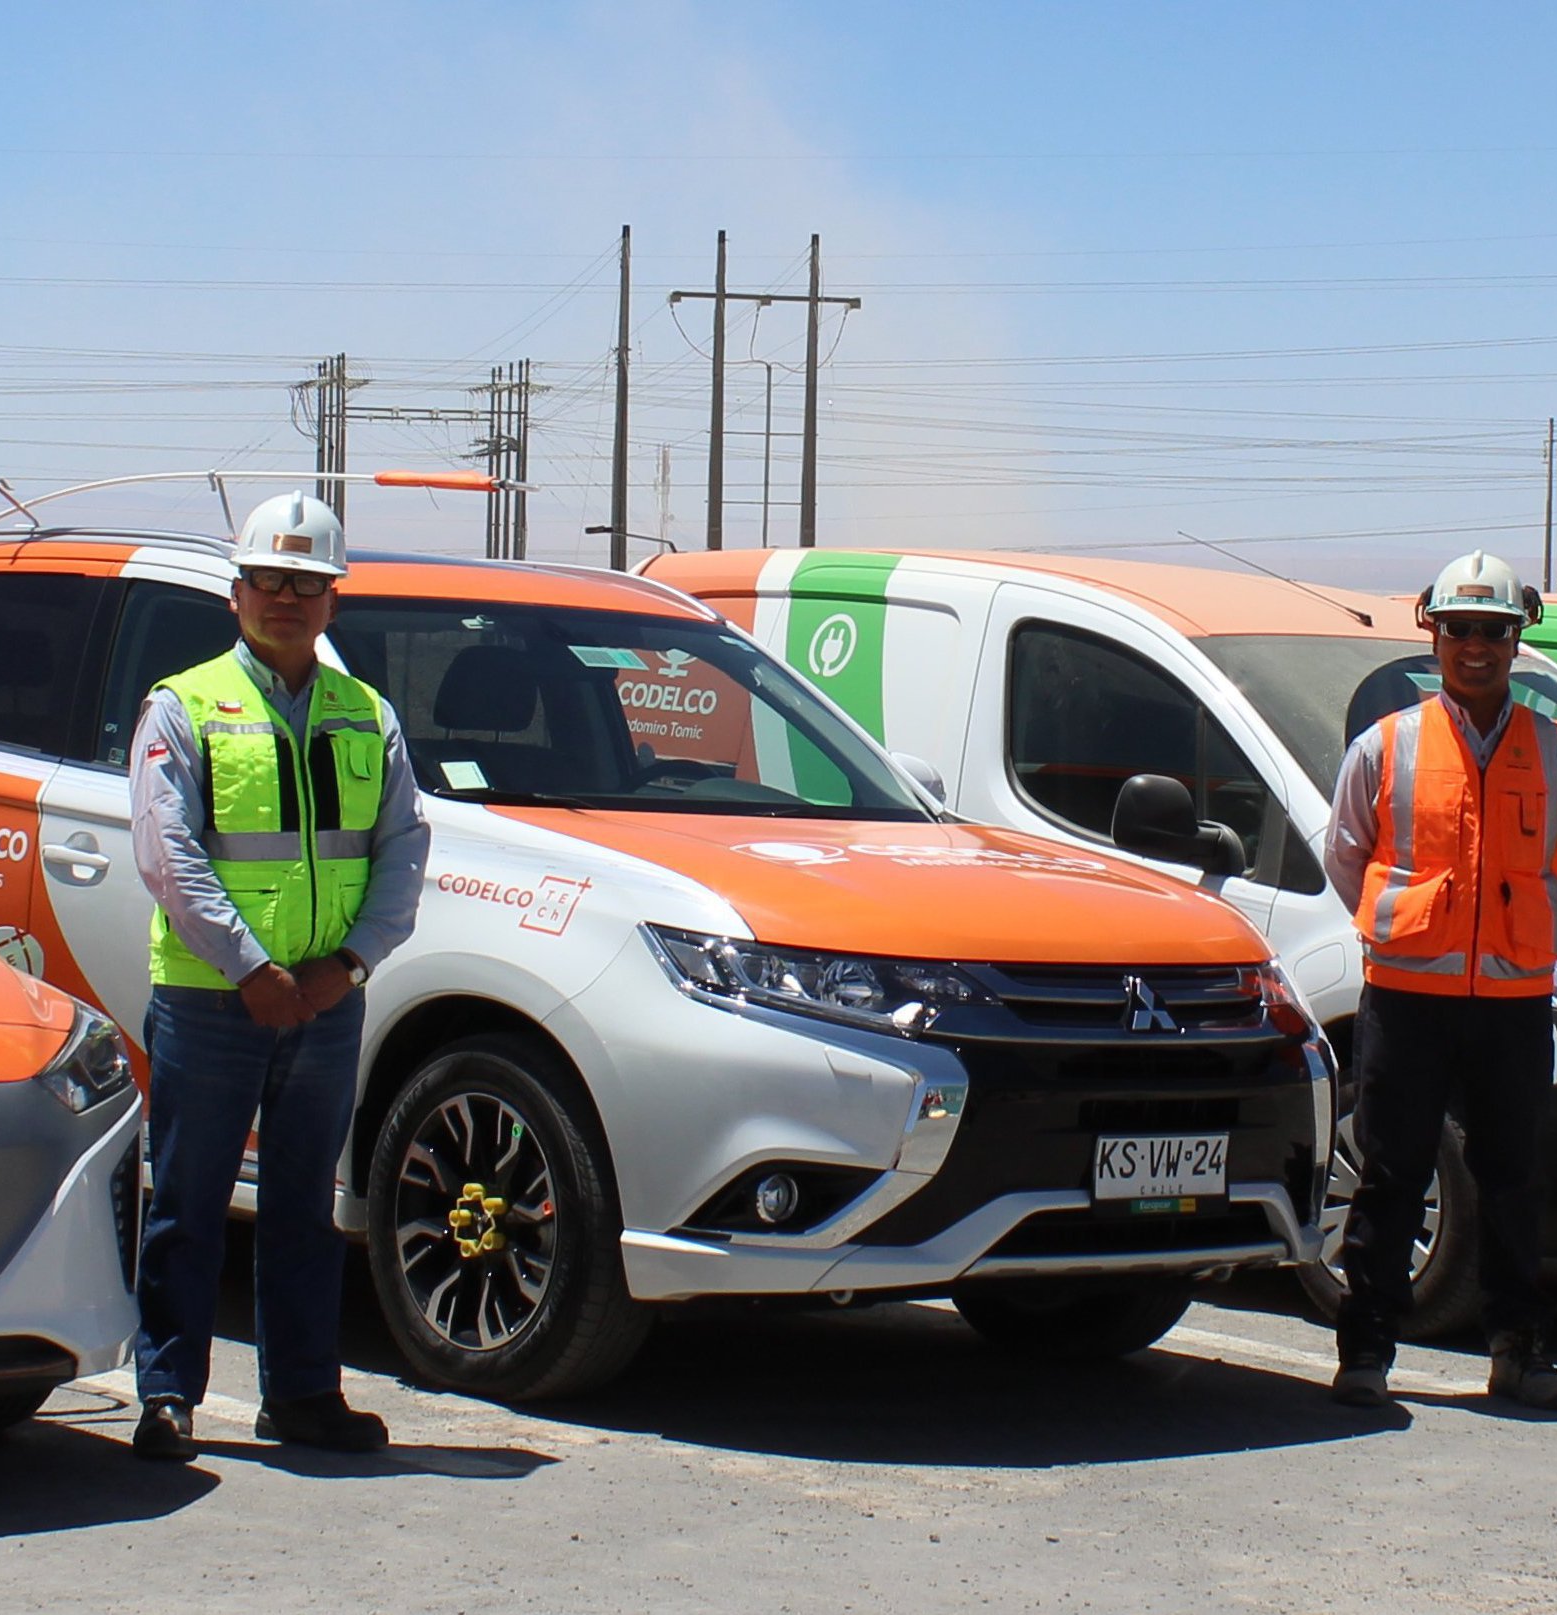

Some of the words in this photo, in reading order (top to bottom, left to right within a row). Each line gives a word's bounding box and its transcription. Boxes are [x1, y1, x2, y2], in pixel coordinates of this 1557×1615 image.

[618, 681, 717, 715] CODELCO
[627, 718, 667, 736] domiro
[671, 721, 703, 740] Tomic
[438, 873, 534, 908] CODELCO
[1140, 1184, 1183, 1196] CHILE
